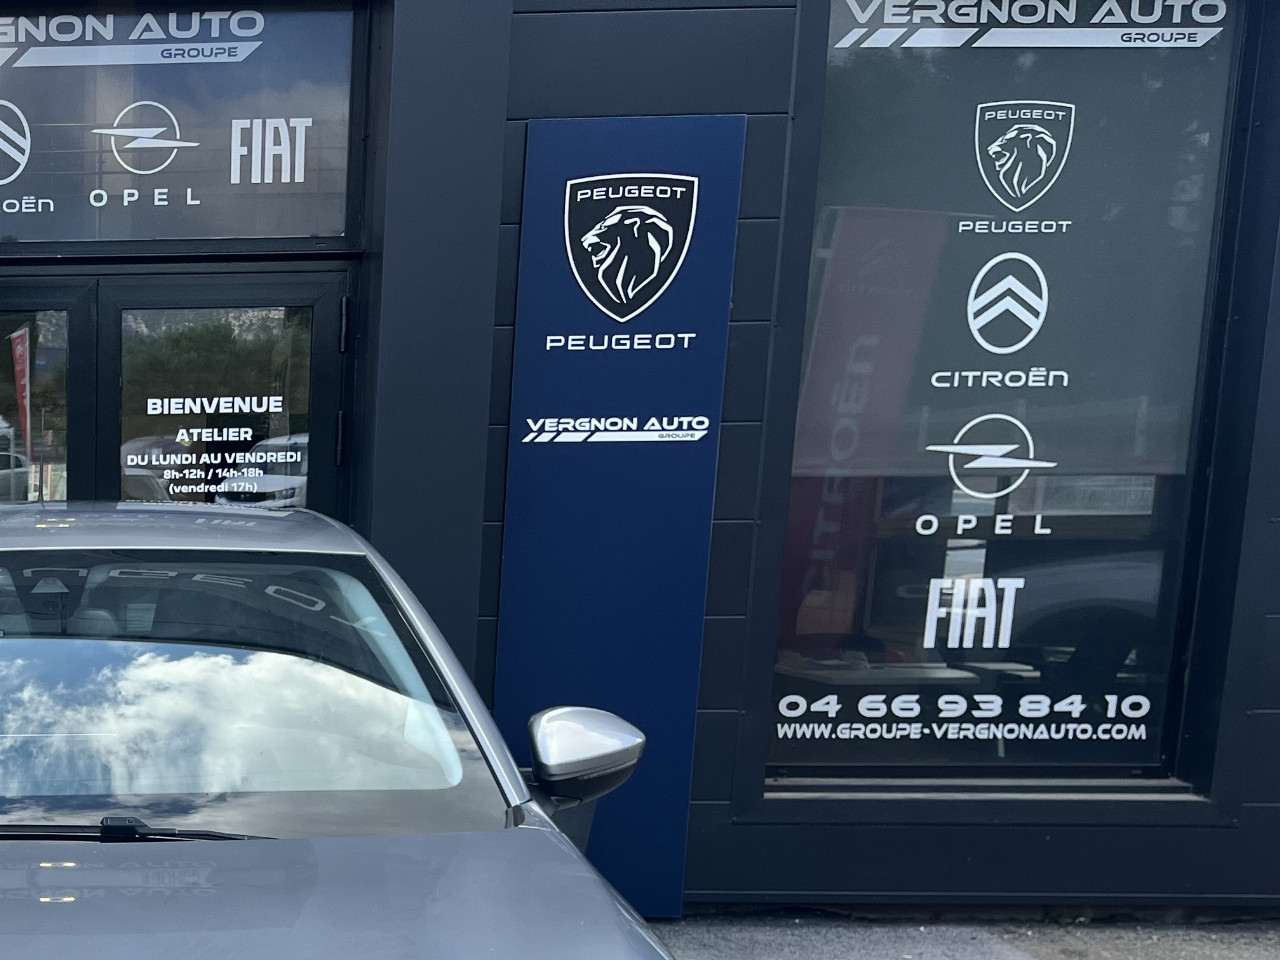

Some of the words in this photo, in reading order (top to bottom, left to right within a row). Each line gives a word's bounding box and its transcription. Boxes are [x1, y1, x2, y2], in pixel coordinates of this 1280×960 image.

[845, 0, 1076, 25] VERGNON
[1089, 0, 1227, 24] AUTO
[128, 10, 265, 41] AUTO
[1120, 32, 1199, 43] GROUPE
[160, 46, 239, 60] GROUPE
[984, 108, 1067, 121] PEUGEOT
[230, 117, 313, 185] FIAT
[89, 187, 201, 207] OPEL
[576, 185, 687, 202] PEUGEOT
[958, 220, 1073, 233] PEUGEOT
[546, 333, 697, 351] PEUGEOT
[147, 395, 283, 415] BIENVENUE
[526, 417, 638, 432] VERGNON
[643, 415, 710, 431] AUTO
[175, 427, 253, 443] ATELIER
[127, 454, 149, 466] DU
[151, 453, 197, 466] LUNDI
[198, 452, 222, 465] AU
[224, 451, 302, 464] VENDREDI
[163, 468, 206, 480] 8h-12h
[215, 467, 264, 479] 14h-18h
[168, 482, 229, 495] (vendredi
[231, 481, 259, 494] 17h)
[915, 514, 1053, 536] OPEL
[922, 577, 1026, 649] FIAT
[778, 694, 842, 718] 04
[857, 694, 921, 718] 66
[937, 694, 1003, 718] 93
[1018, 694, 1087, 718] 84
[1104, 694, 1151, 718] 10
[776, 722, 1147, 741] WWW.GROUPE-VERGNONAUTO.COM
